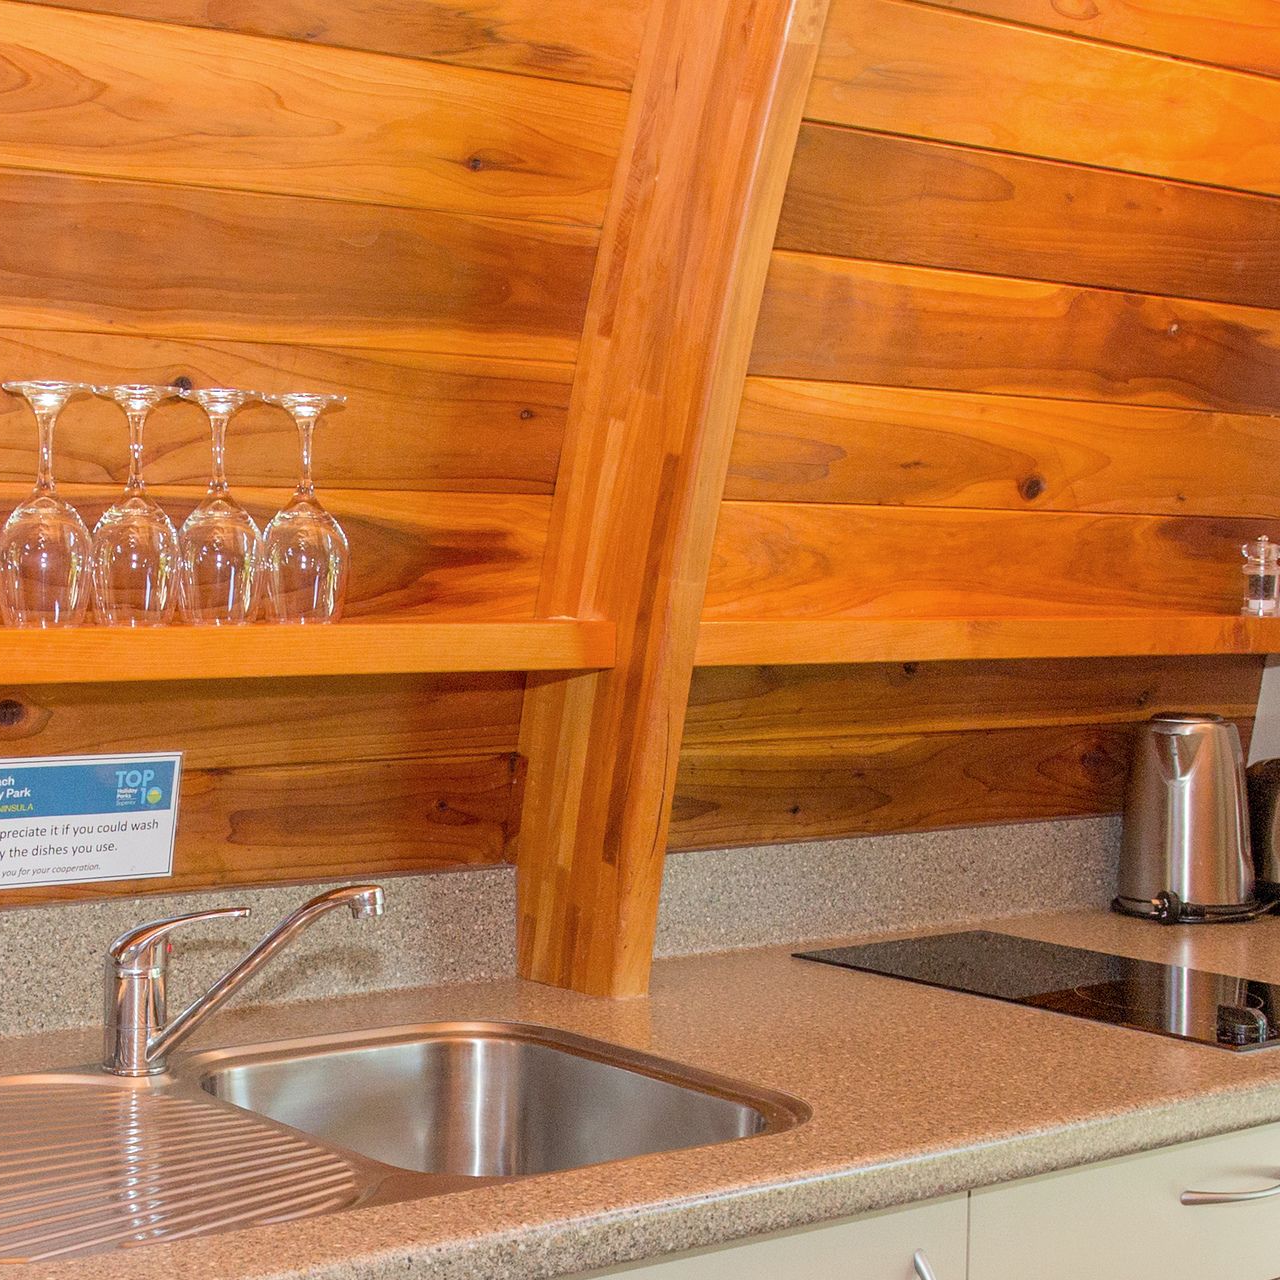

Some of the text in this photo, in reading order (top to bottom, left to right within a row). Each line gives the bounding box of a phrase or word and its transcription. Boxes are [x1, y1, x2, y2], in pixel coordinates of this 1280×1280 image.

[116, 770, 154, 788] TOP
[6, 788, 31, 798] Park
[50, 825, 58, 836] it
[62, 825, 69, 835] if
[73, 824, 94, 837] you
[97, 821, 128, 834] could
[131, 819, 159, 831] wash
[9, 847, 28, 858] the
[31, 844, 68, 857] dishes
[71, 845, 92, 857] you
[96, 843, 117, 852] use.
[2, 870, 17, 879] you
[18, 868, 30, 877] for
[31, 867, 51, 876] your
[52, 863, 101, 875] cooperation.
